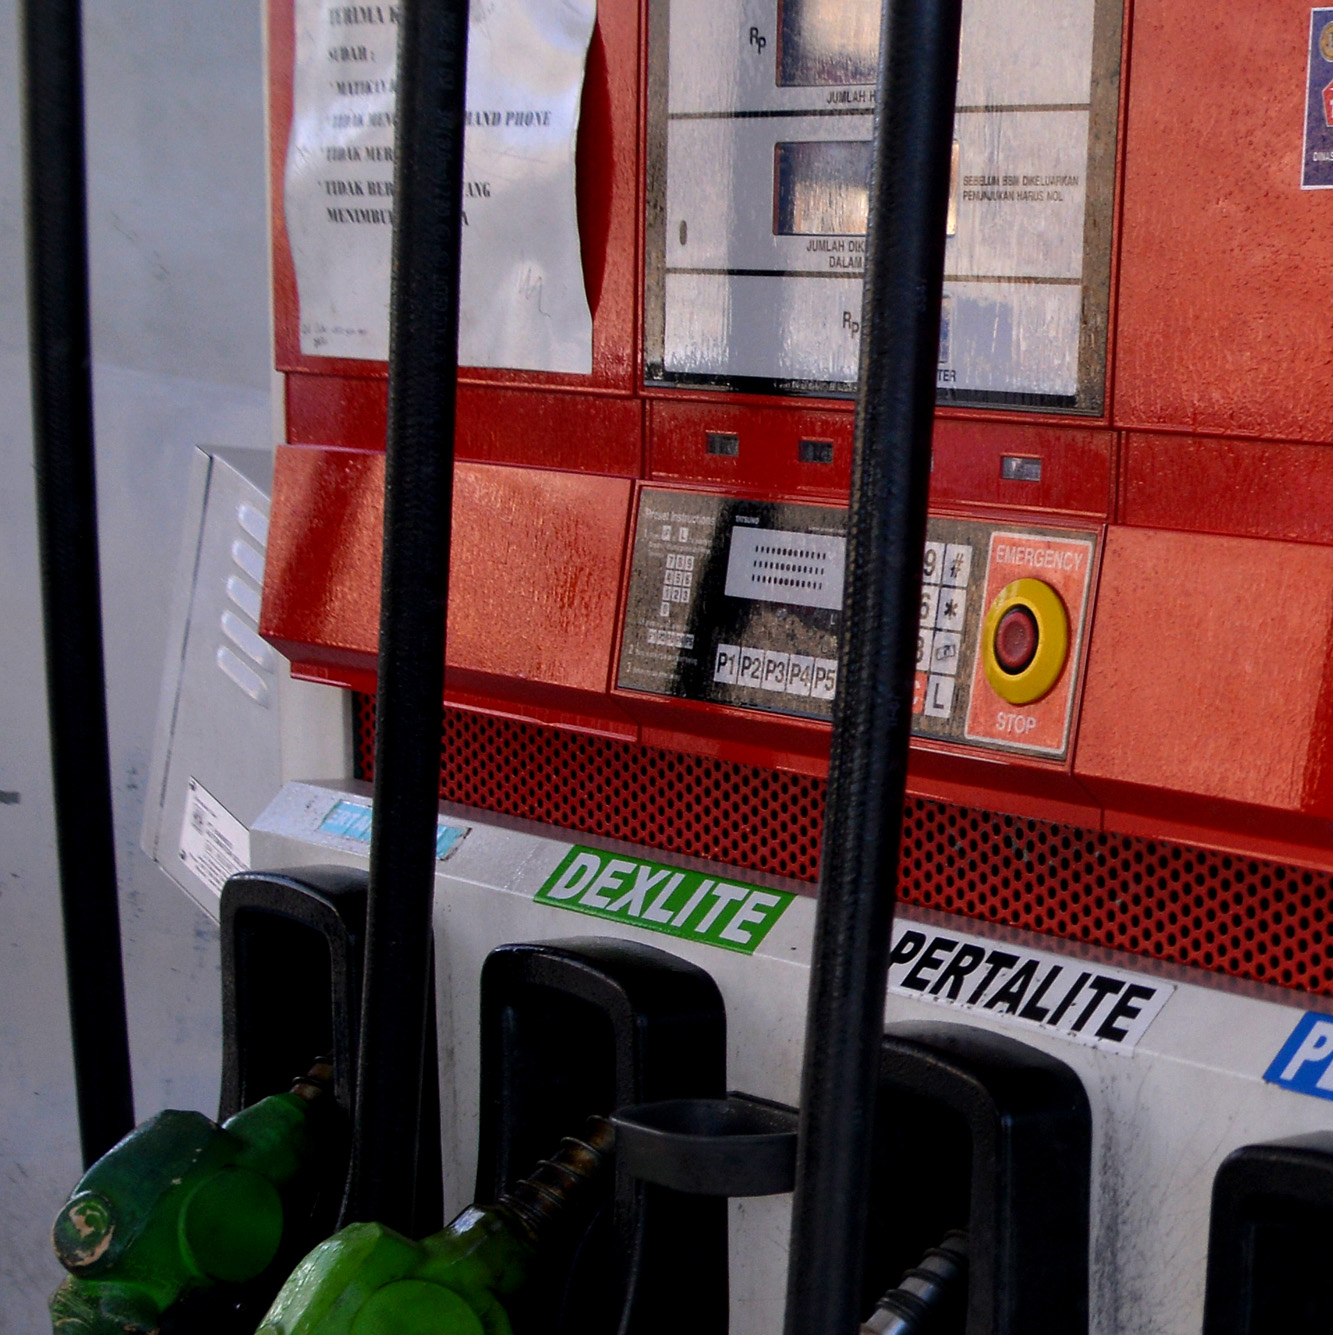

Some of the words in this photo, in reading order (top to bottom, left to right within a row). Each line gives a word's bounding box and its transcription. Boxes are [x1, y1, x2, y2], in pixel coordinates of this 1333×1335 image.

[827, 90, 866, 104] JUMLAH
[505, 111, 551, 127] PHONE
[326, 180, 364, 196] TIDAK
[1016, 190, 1043, 201] HARUS
[806, 240, 845, 252] JUMLAH
[829, 256, 862, 269] DALAM
[995, 545, 1083, 571] EMERGENCY
[717, 652, 735, 676] P1
[741, 655, 760, 680] P2
[764, 658, 785, 684] P3
[788, 661, 810, 687] P4
[814, 665, 836, 690] P5
[932, 683, 945, 710] L
[995, 712, 1037, 734] STOP
[546, 850, 784, 945] DEXLITE
[887, 927, 1157, 1044] PERTALITE
